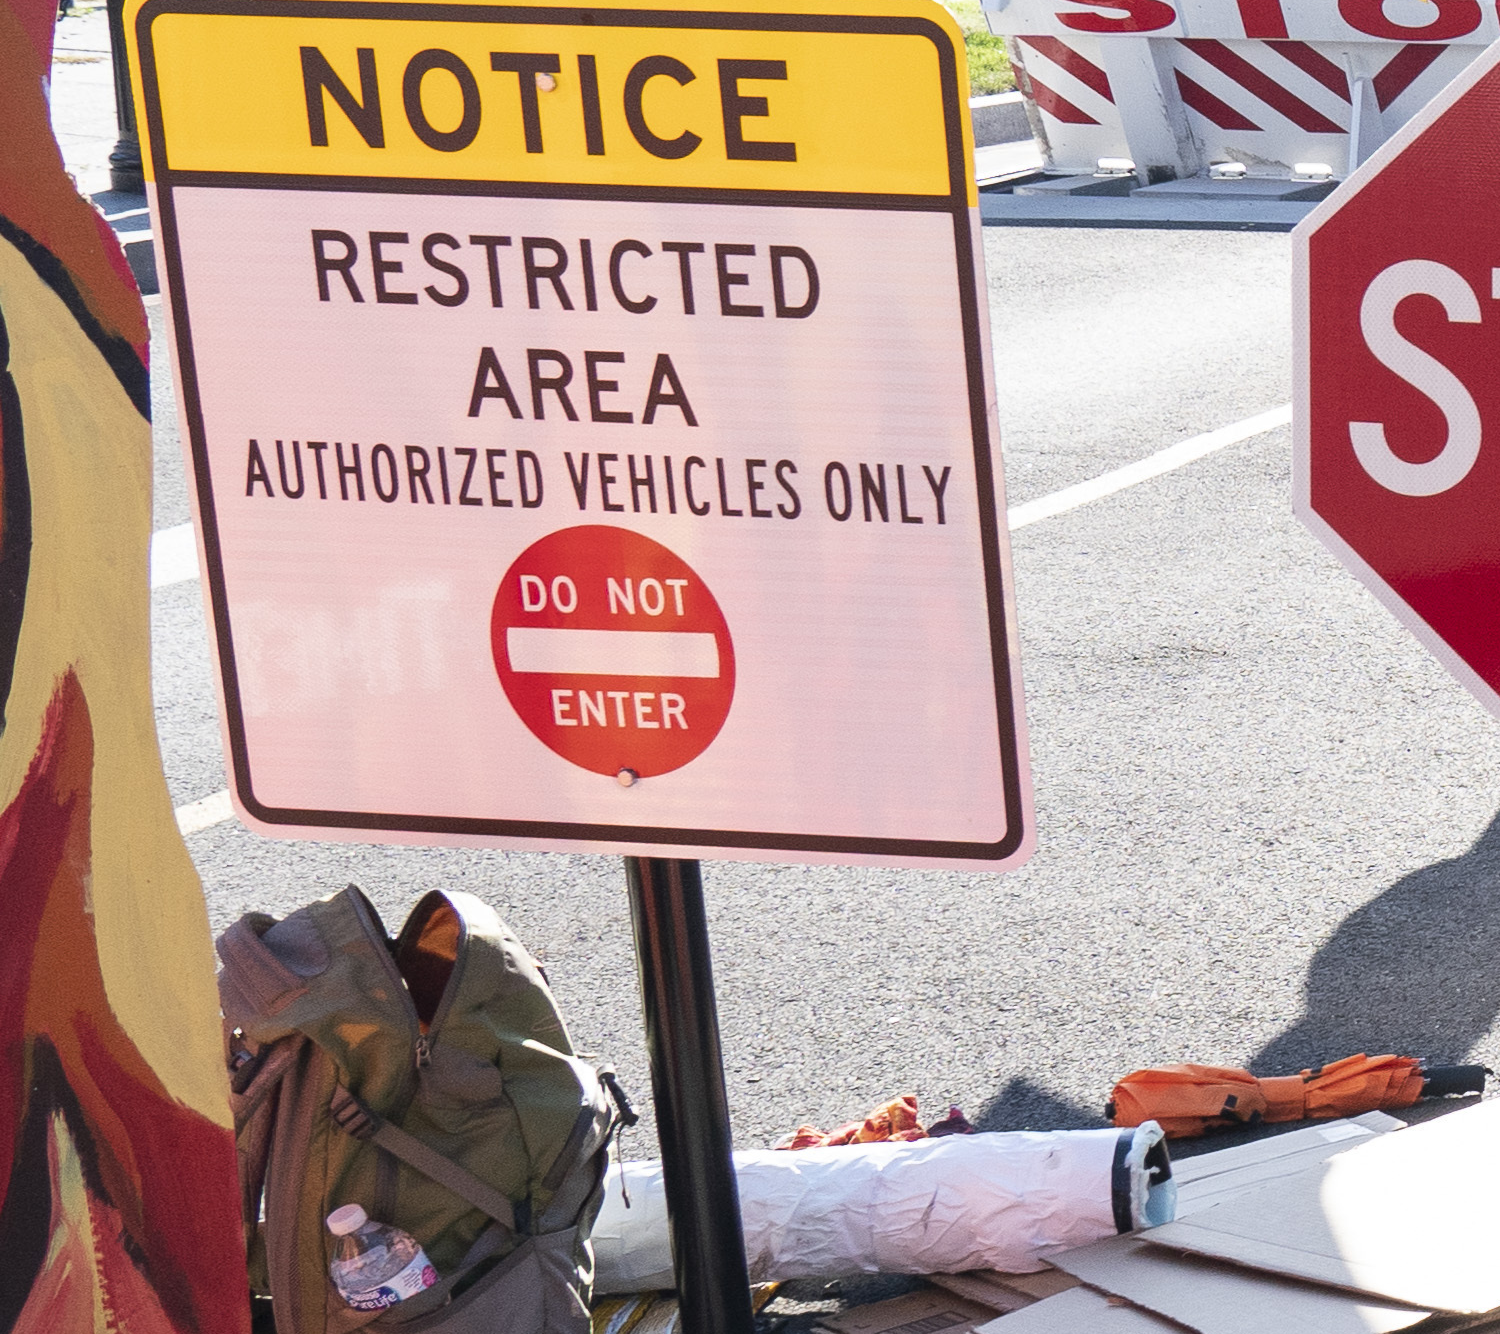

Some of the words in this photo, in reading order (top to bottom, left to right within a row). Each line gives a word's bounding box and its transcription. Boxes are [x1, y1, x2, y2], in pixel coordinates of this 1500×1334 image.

[299, 46, 797, 162] NOTICE
[311, 229, 820, 319] RESTRICTED
[466, 346, 698, 427] AREA
[245, 439, 545, 509] AUTHORIZED
[565, 451, 802, 521] VEHICLES
[824, 465, 951, 526] ONLY
[521, 575, 577, 614] DO
[607, 578, 689, 616] NOT
[551, 690, 688, 730] ENTER
